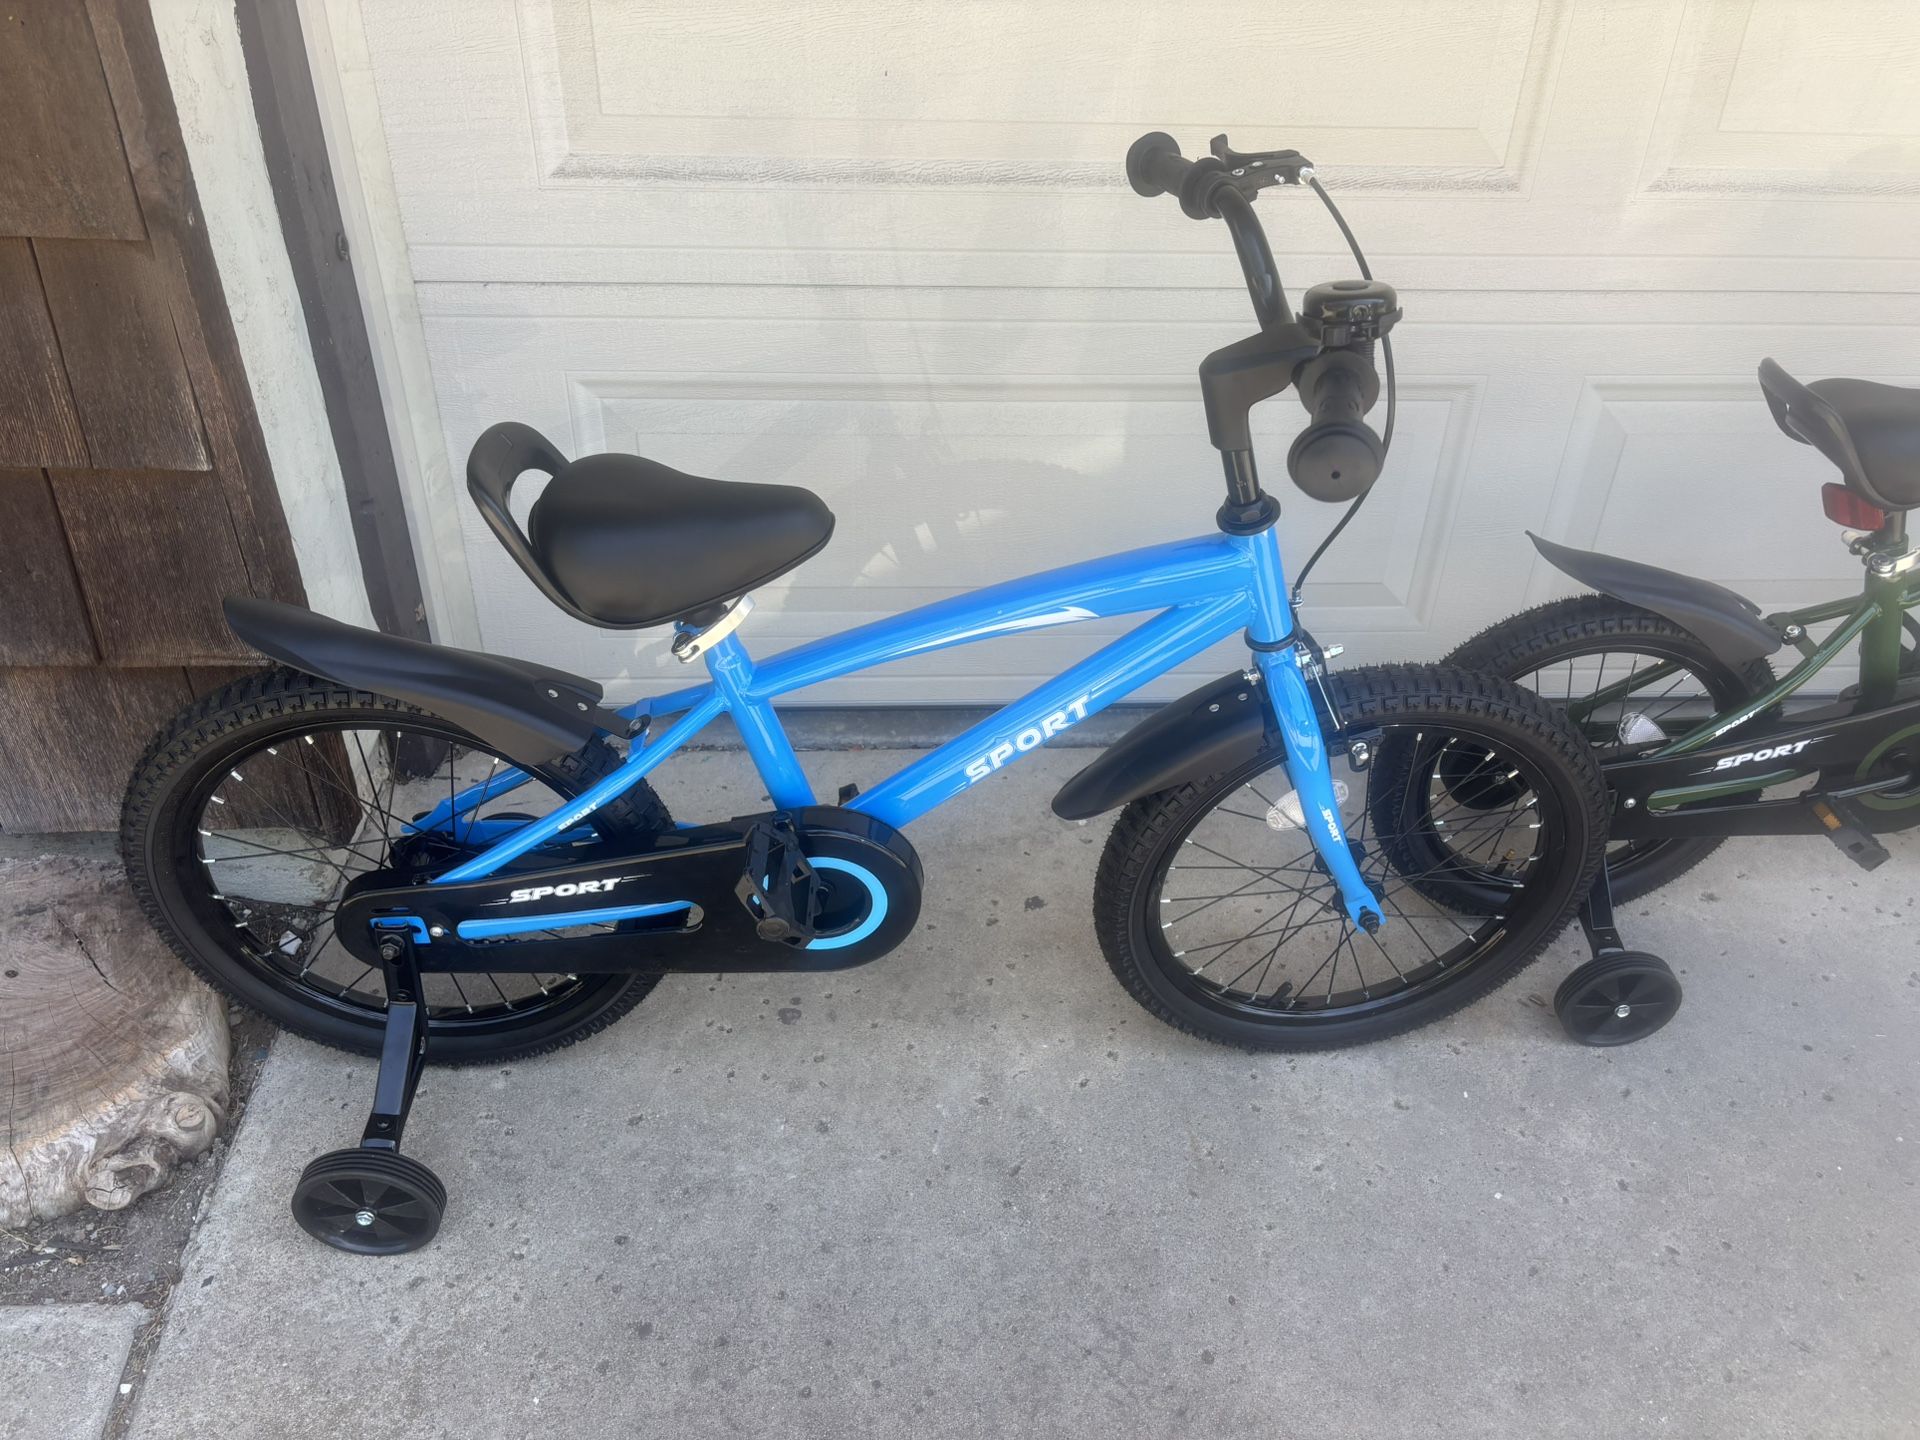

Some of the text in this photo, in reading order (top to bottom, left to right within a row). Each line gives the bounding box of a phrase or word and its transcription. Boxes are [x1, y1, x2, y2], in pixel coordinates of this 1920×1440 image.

[964, 694, 1089, 784] SPORT
[1714, 739, 1812, 771] SPORT
[1321, 808, 1342, 842] SPORT
[509, 877, 622, 904] SPORT
